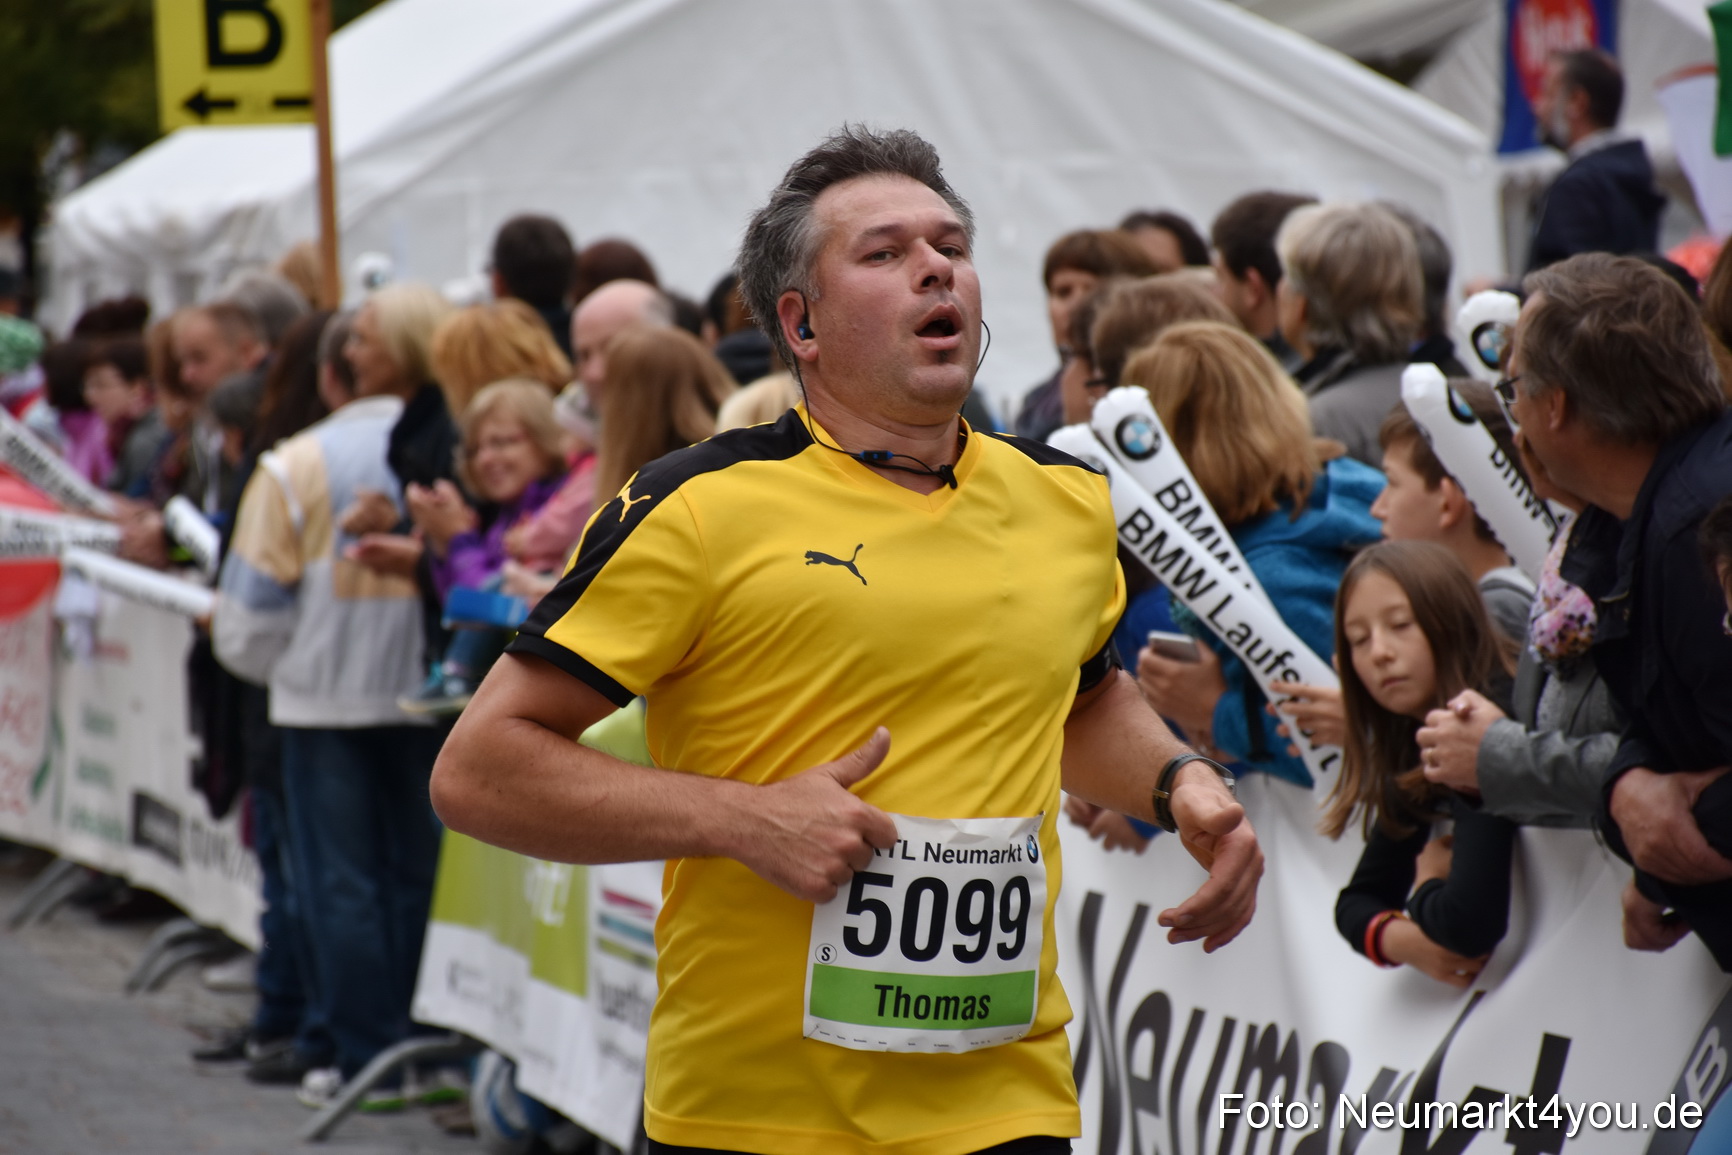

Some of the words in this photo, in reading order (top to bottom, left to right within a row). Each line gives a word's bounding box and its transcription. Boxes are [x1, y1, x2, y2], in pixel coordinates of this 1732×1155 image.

[204, 0, 286, 70] B
[1118, 507, 1218, 601] BMW
[923, 841, 1023, 865] Neumarkt
[842, 869, 1031, 965] 5099
[820, 946, 831, 962] S
[873, 983, 992, 1021] Thomas
